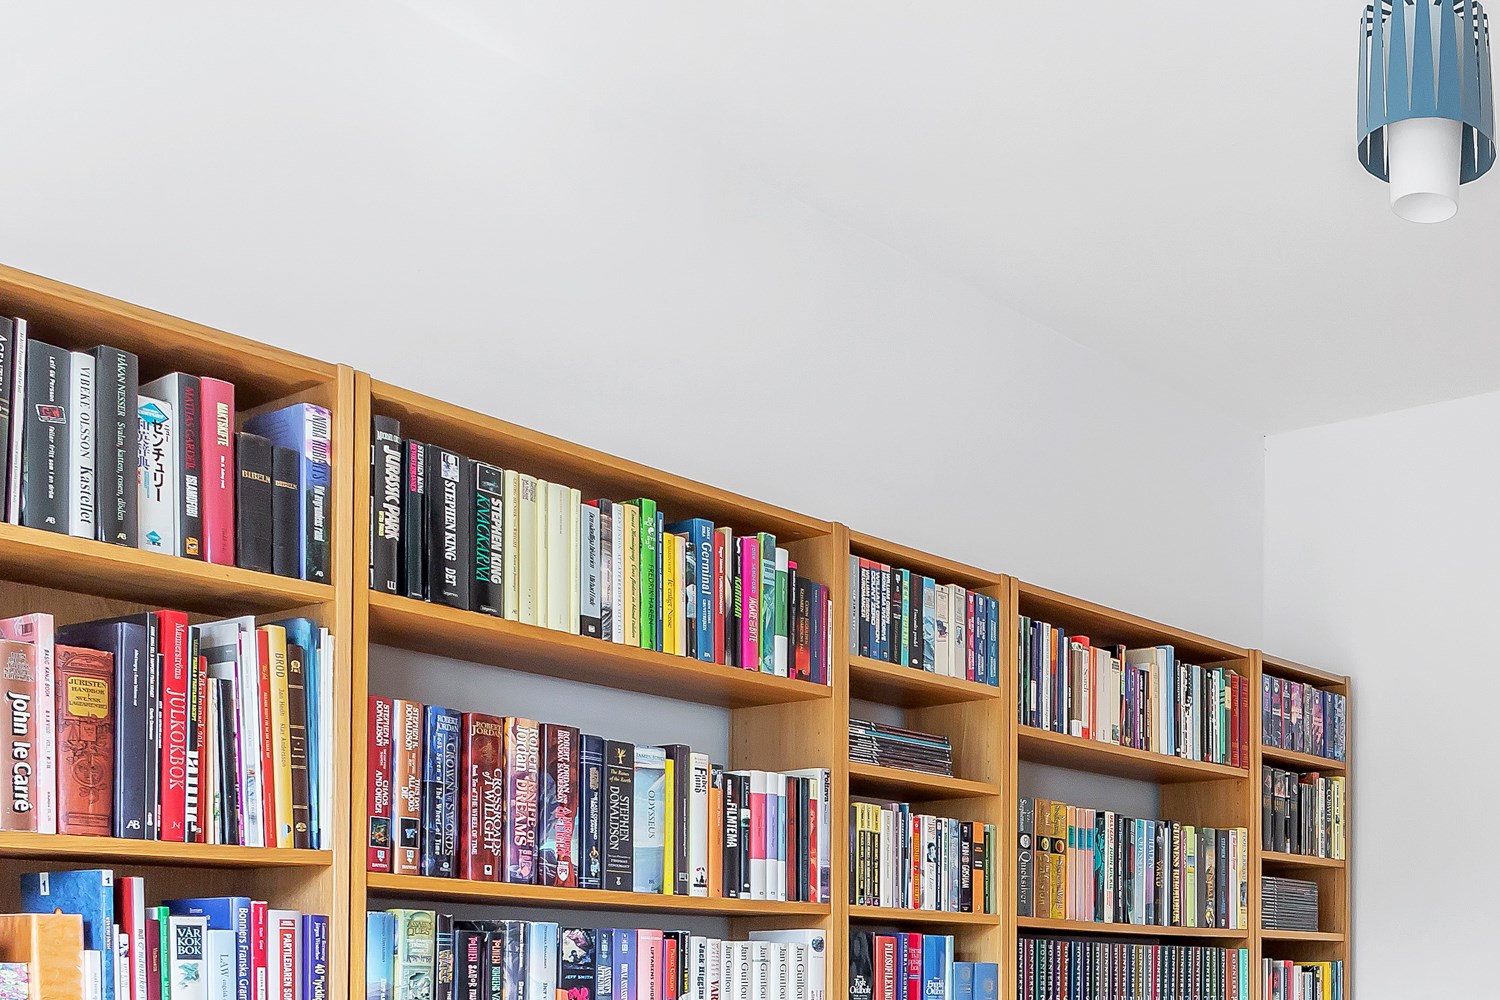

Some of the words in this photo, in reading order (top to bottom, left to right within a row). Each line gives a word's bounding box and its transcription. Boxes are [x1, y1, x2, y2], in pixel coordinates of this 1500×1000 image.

[80, 367, 90, 409] VIBEKE
[117, 384, 126, 416] NESSER
[80, 413, 90, 458] OLSSON
[217, 402, 228, 446] MAKTSKIFTE
[80, 466, 93, 524] Kastellet
[384, 446, 400, 503] JURASSIC
[383, 505, 400, 541] PARK
[444, 480, 456, 529] STEPHEN
[491, 498, 502, 551] STEPHEN
[444, 531, 456, 561] KING
[476, 493, 489, 582] KNACKARNA
[445, 567, 456, 586] DET
[491, 553, 502, 584] KING
[701, 542, 711, 594] Germinal
[174, 623, 185, 679] Mannerströms
[8, 693, 30, 735] John
[15, 742, 31, 760] le
[167, 688, 185, 790] JULKOKBOK
[516, 726, 528, 772] Jordan
[529, 728, 539, 774] Robert
[12, 762, 33, 813] Carré
[493, 768, 501, 856] CROSSROADS
[515, 779, 526, 846] DREAMS
[609, 786, 619, 850] DONALDSON
[620, 796, 629, 841] STEPHEN
[648, 790, 656, 838] ODYSSEUS
[726, 803, 737, 847] FILMTEMA
[178, 937, 202, 946] KOK
[239, 908, 249, 943] Bonniers
[178, 946, 201, 955] BOK
[220, 954, 229, 978] LAW
[239, 945, 248, 976] Franska
[283, 934, 293, 987] PARTILEDAREN
[698, 943, 706, 964] Jack
[778, 947, 787, 962] Jan
[795, 946, 804, 962] Jan
[696, 966, 705, 1000] Higgins
[725, 961, 733, 993] Guillou
[759, 963, 768, 999] Guillou
[779, 964, 787, 999] Guillou
[796, 964, 804, 999] Guillou
